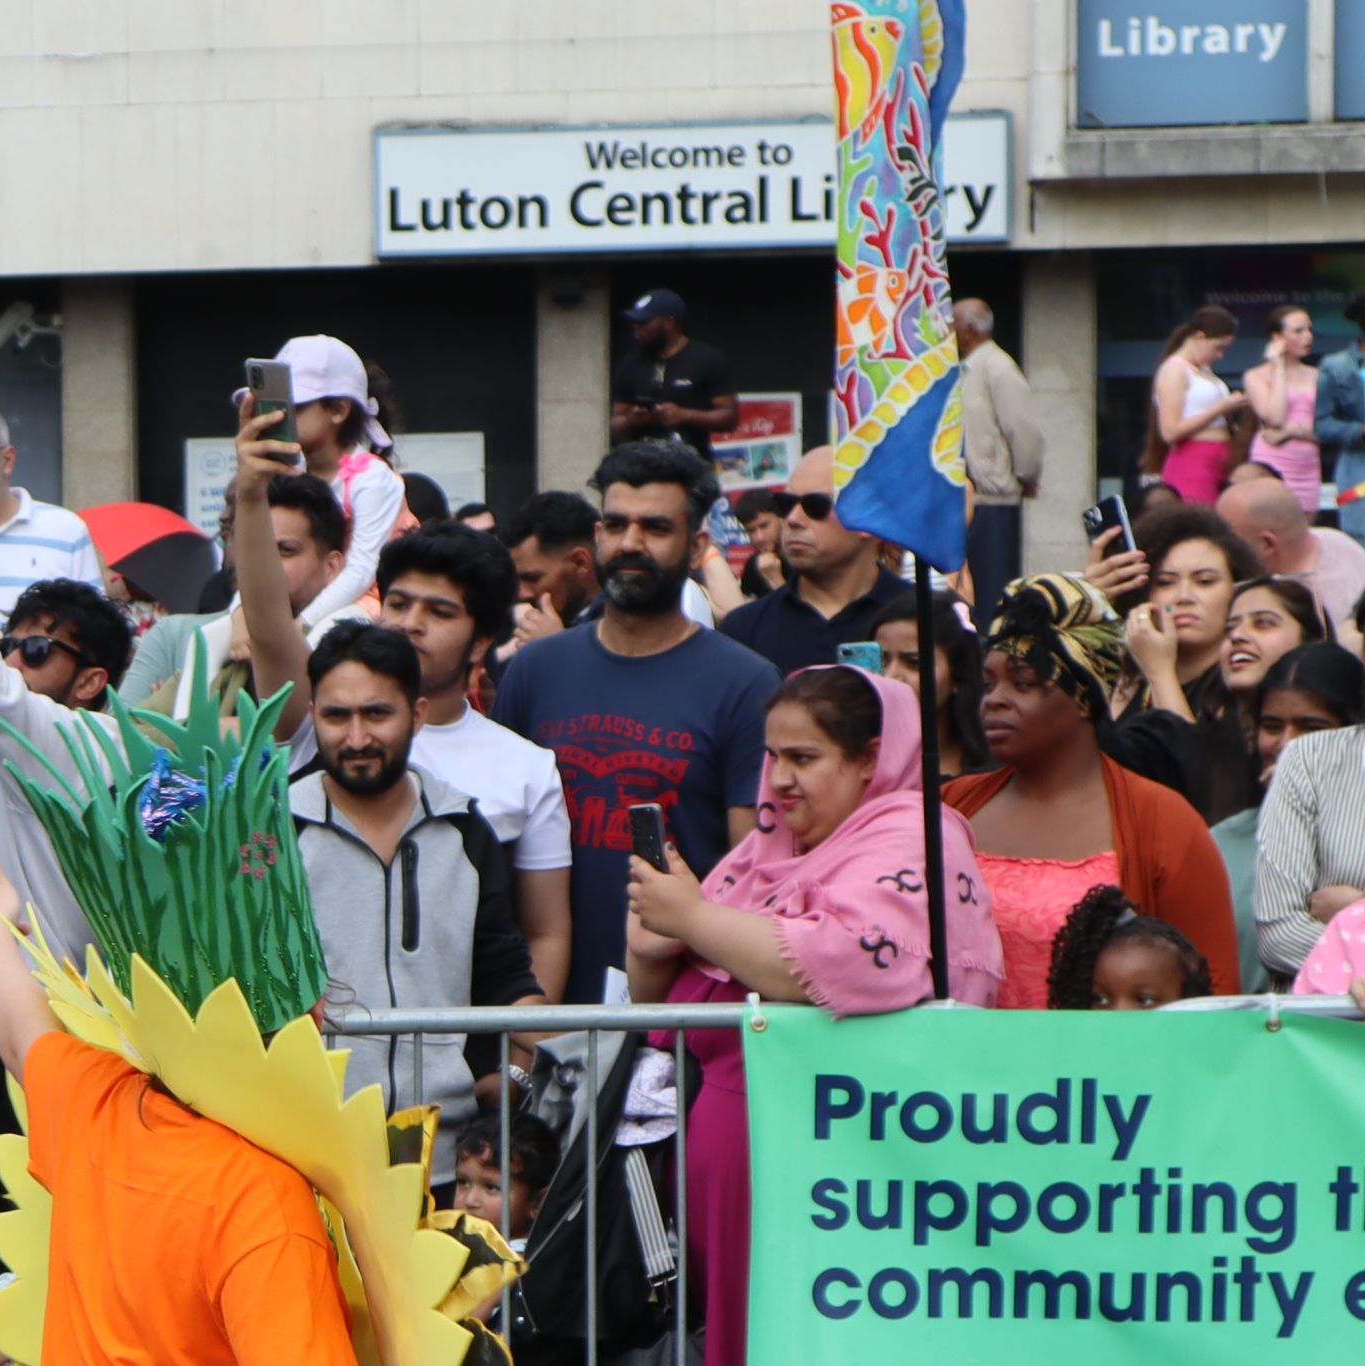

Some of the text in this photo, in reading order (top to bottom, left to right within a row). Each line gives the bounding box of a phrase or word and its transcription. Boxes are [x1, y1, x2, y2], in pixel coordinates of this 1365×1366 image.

[1097, 18, 1287, 62] Library
[585, 139, 793, 171] Welcome to
[388, 185, 549, 234] Luton
[569, 176, 770, 230] Central
[567, 713, 645, 742] STRAUSS
[648, 727, 662, 746] &
[813, 1074, 1153, 1161] Proudly
[810, 1166, 1299, 1255] supporting
[811, 1255, 1316, 1339] community
